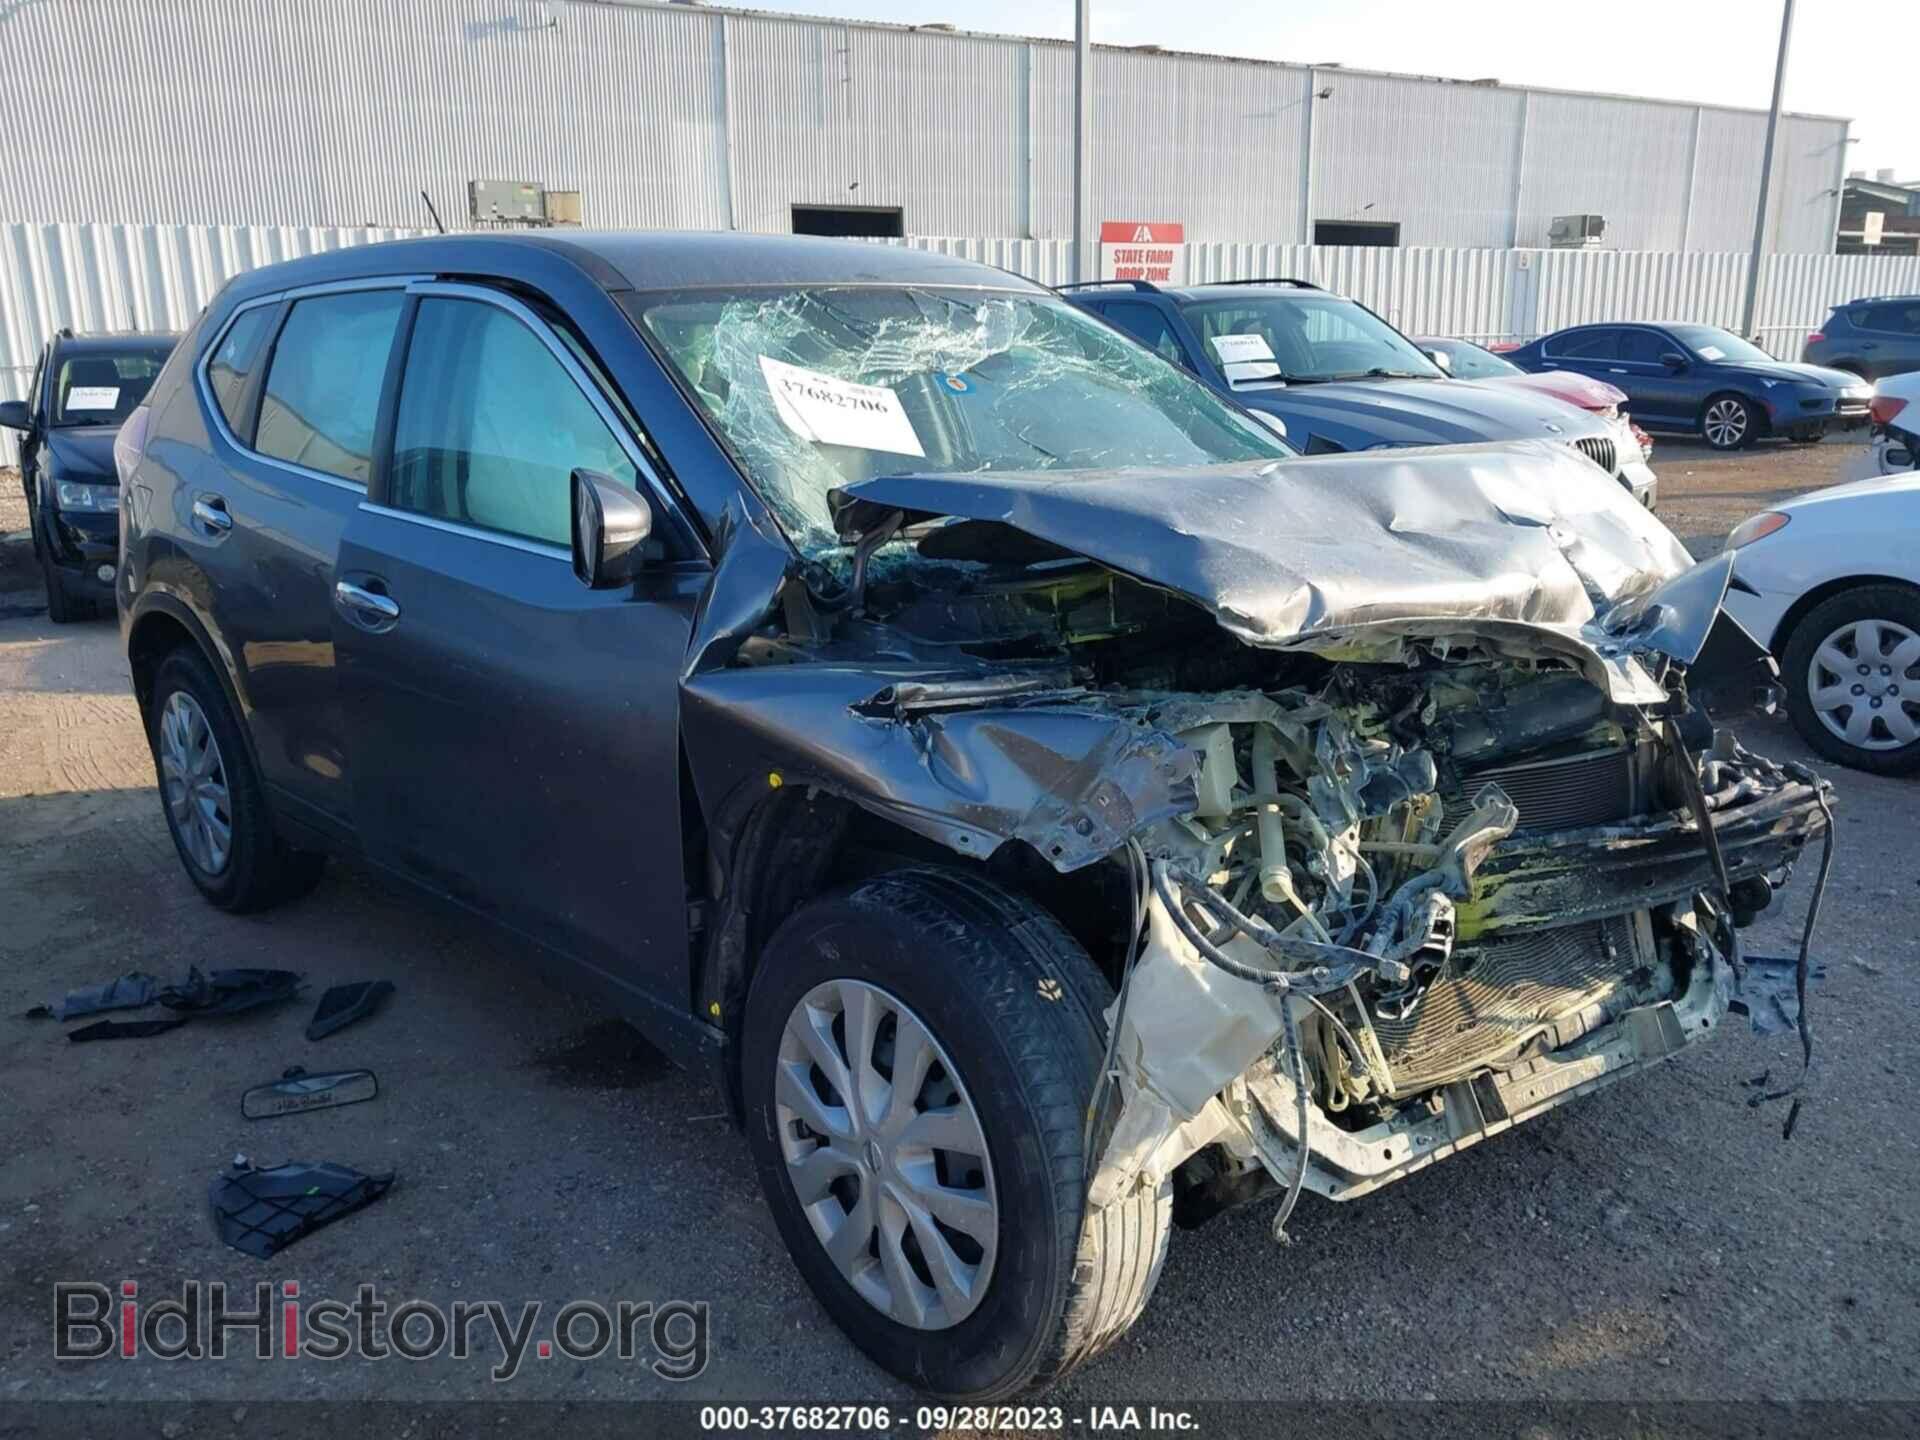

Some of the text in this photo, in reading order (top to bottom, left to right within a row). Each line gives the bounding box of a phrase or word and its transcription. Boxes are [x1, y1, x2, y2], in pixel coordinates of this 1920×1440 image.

[1114, 249, 1173, 263] STATE FARM
[1116, 267, 1170, 281] DROP ZONE
[779, 379, 889, 414] 37682706
